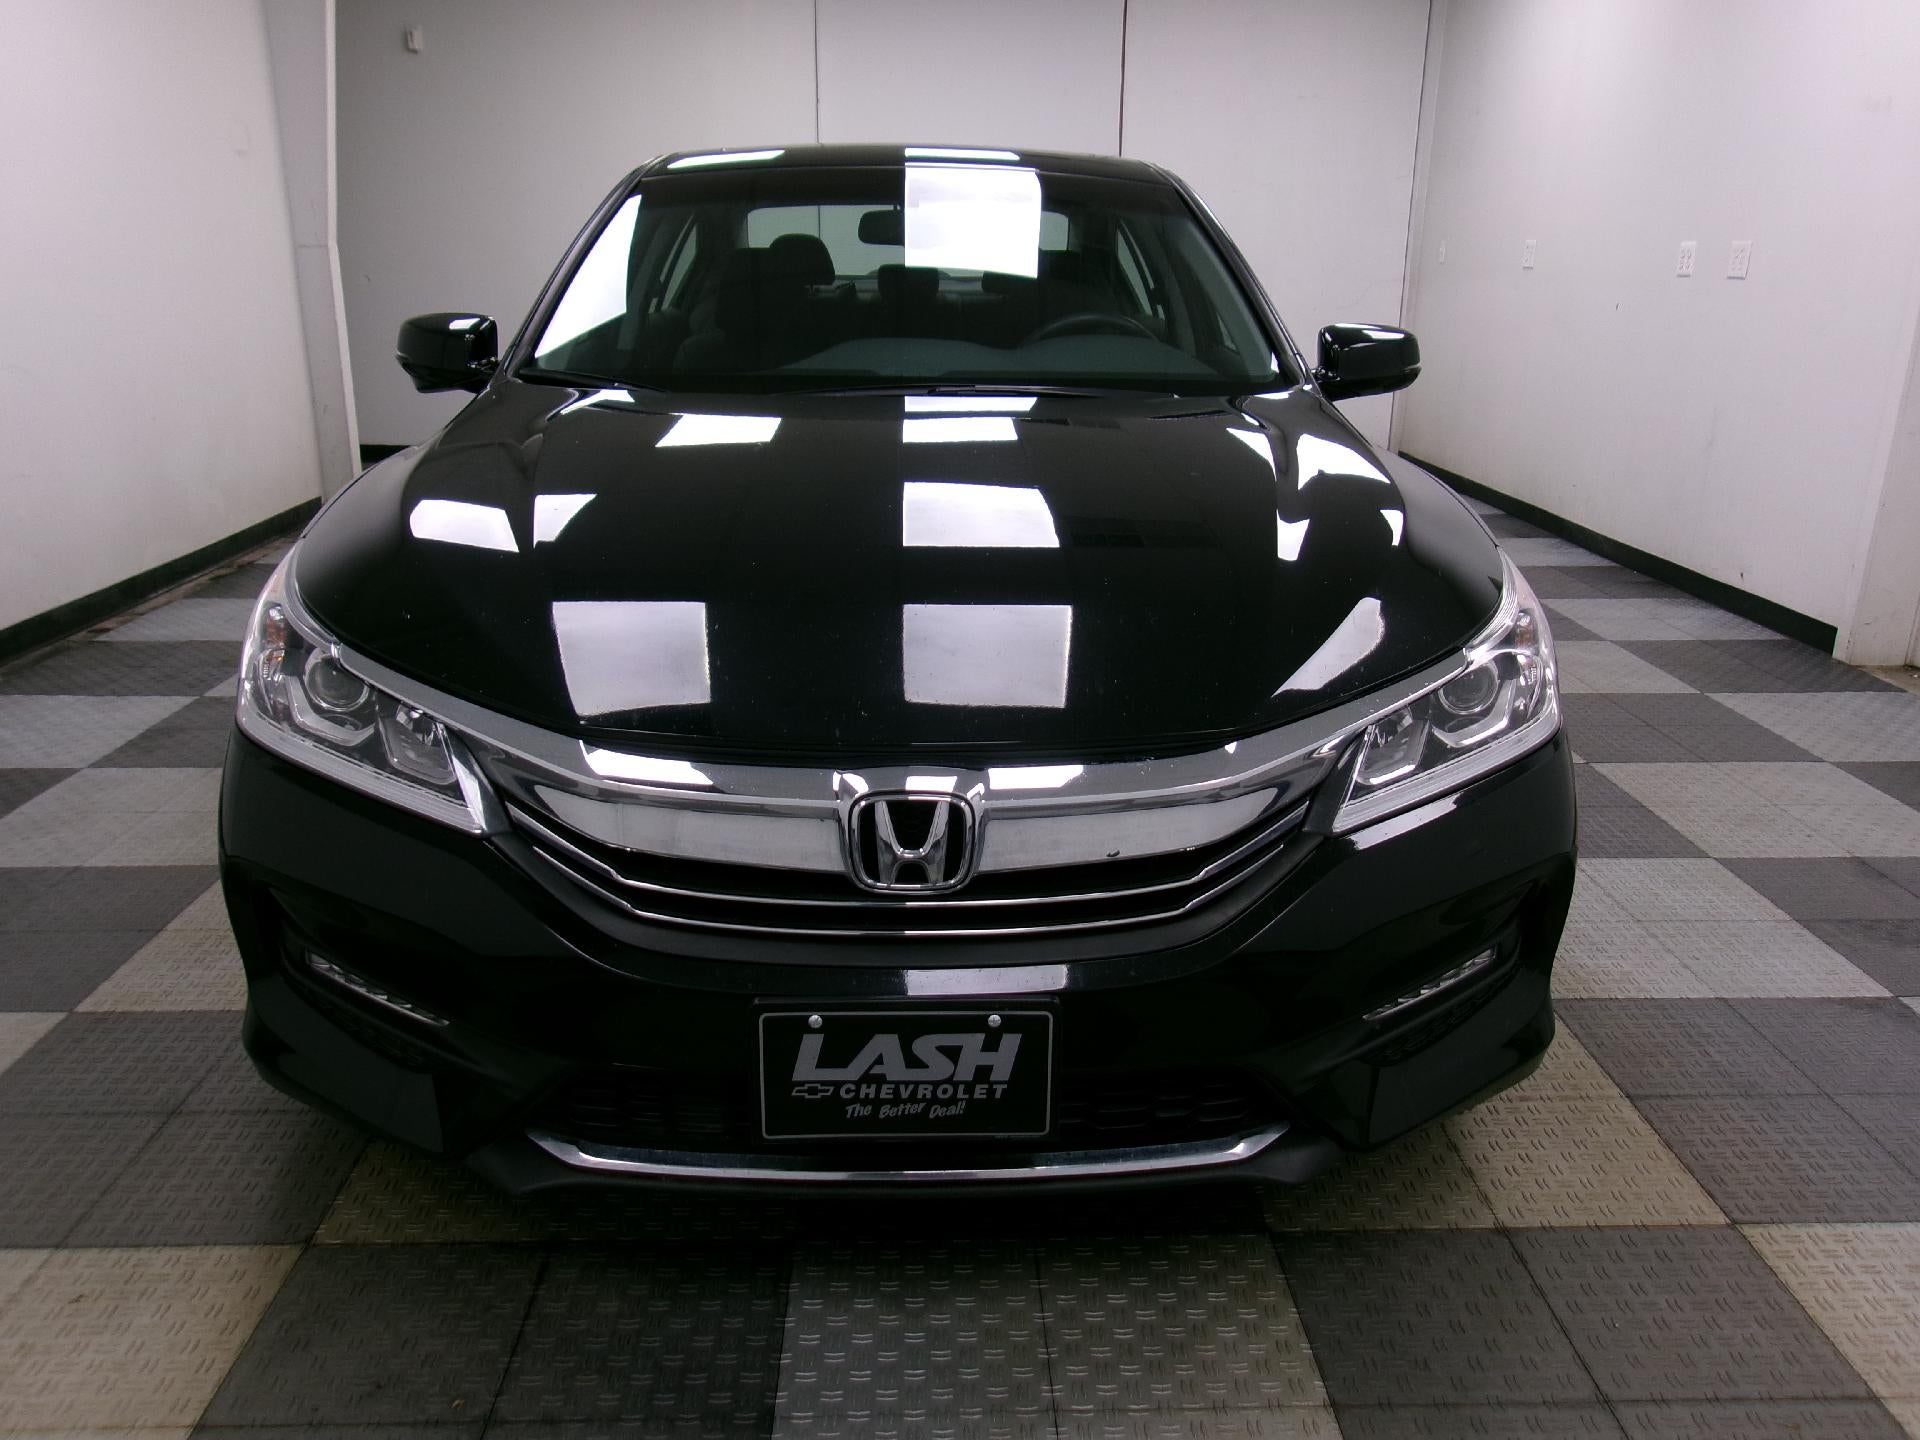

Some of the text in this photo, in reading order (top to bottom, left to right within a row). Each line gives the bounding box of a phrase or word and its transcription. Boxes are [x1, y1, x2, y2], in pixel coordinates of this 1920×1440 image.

[791, 1033, 1022, 1081] LASH
[839, 1083, 1007, 1099] CHEVROLET
[845, 1100, 966, 1119] The Better Deal!
